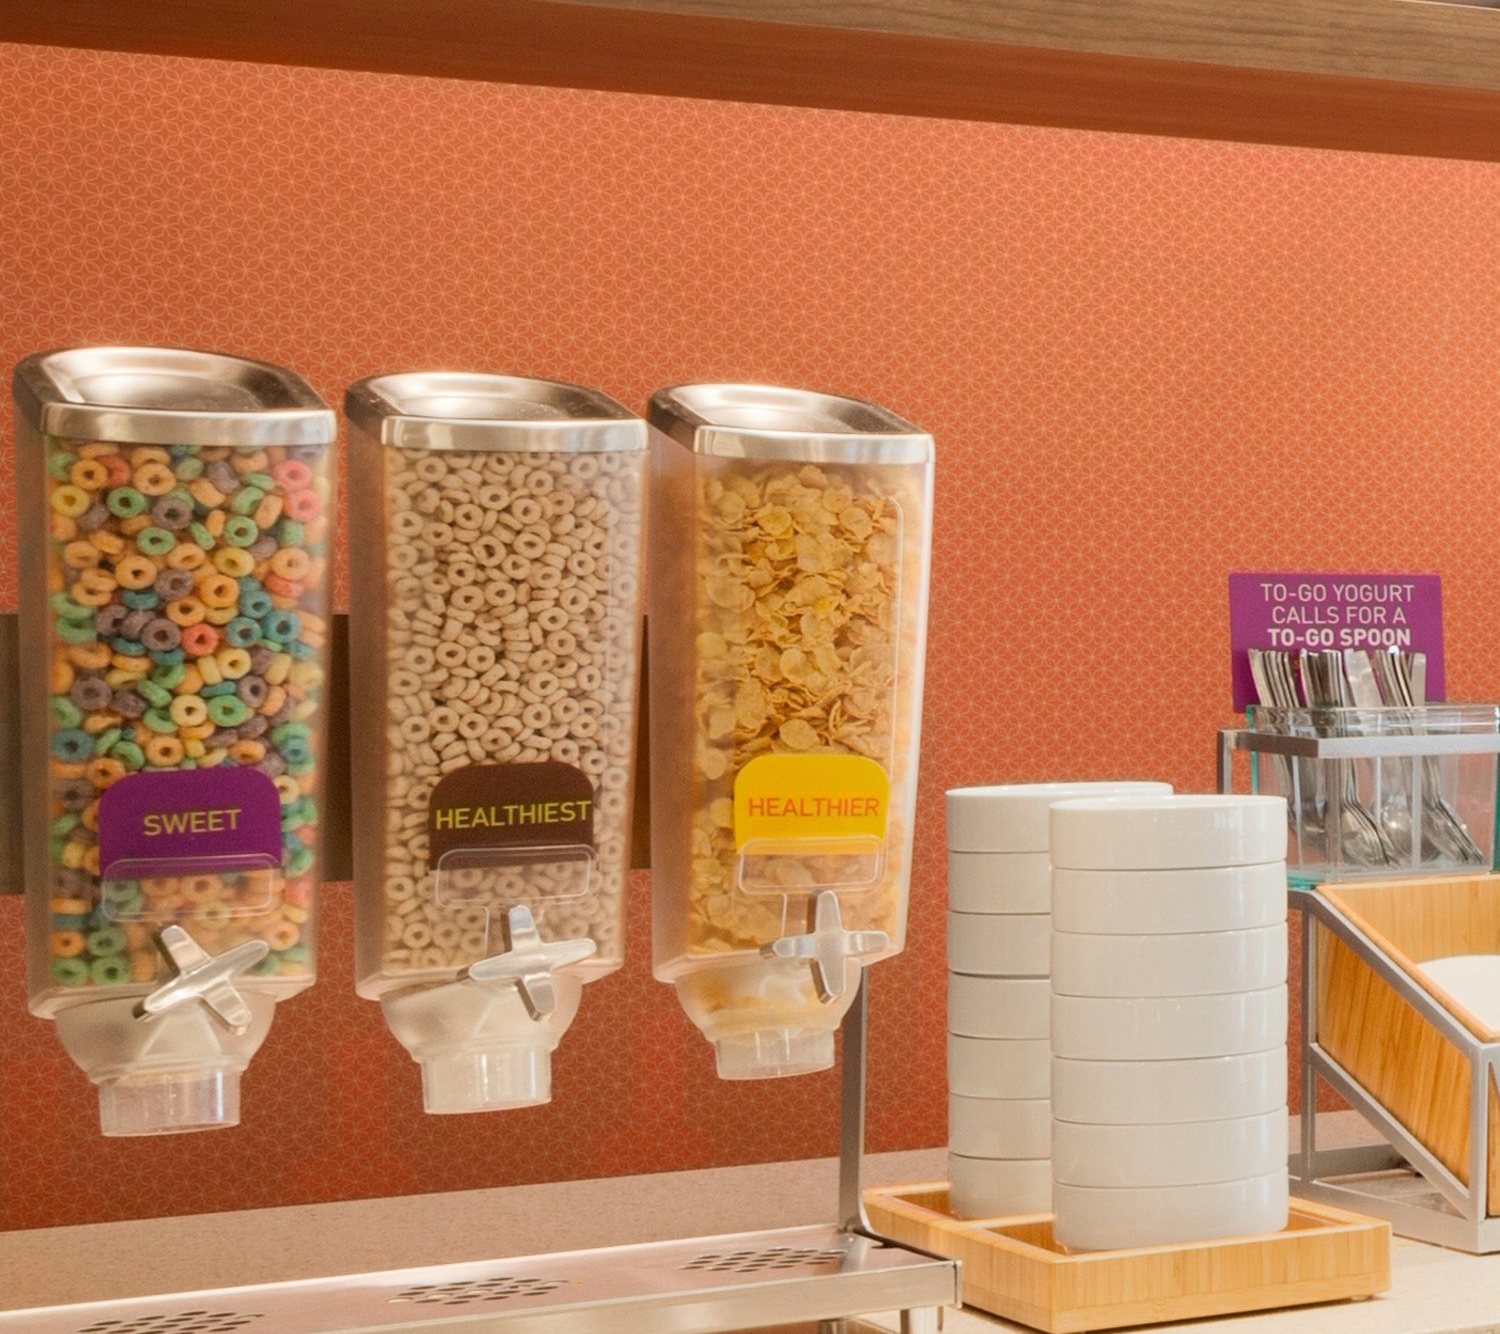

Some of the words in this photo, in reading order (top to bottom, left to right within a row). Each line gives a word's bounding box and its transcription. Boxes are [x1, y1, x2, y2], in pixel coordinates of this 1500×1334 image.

[1260, 583, 1327, 603] TO-GO
[1333, 584, 1415, 603] YOGURT
[1272, 606, 1340, 624] CALLS
[1346, 607, 1387, 624] FOR
[1392, 607, 1407, 624] A
[1267, 628, 1334, 647] TO-GO
[1340, 628, 1411, 646] SPOON
[435, 799, 592, 830] HEALTHIEST
[747, 796, 880, 819] HEALTHIER
[143, 808, 241, 836] SWEET
